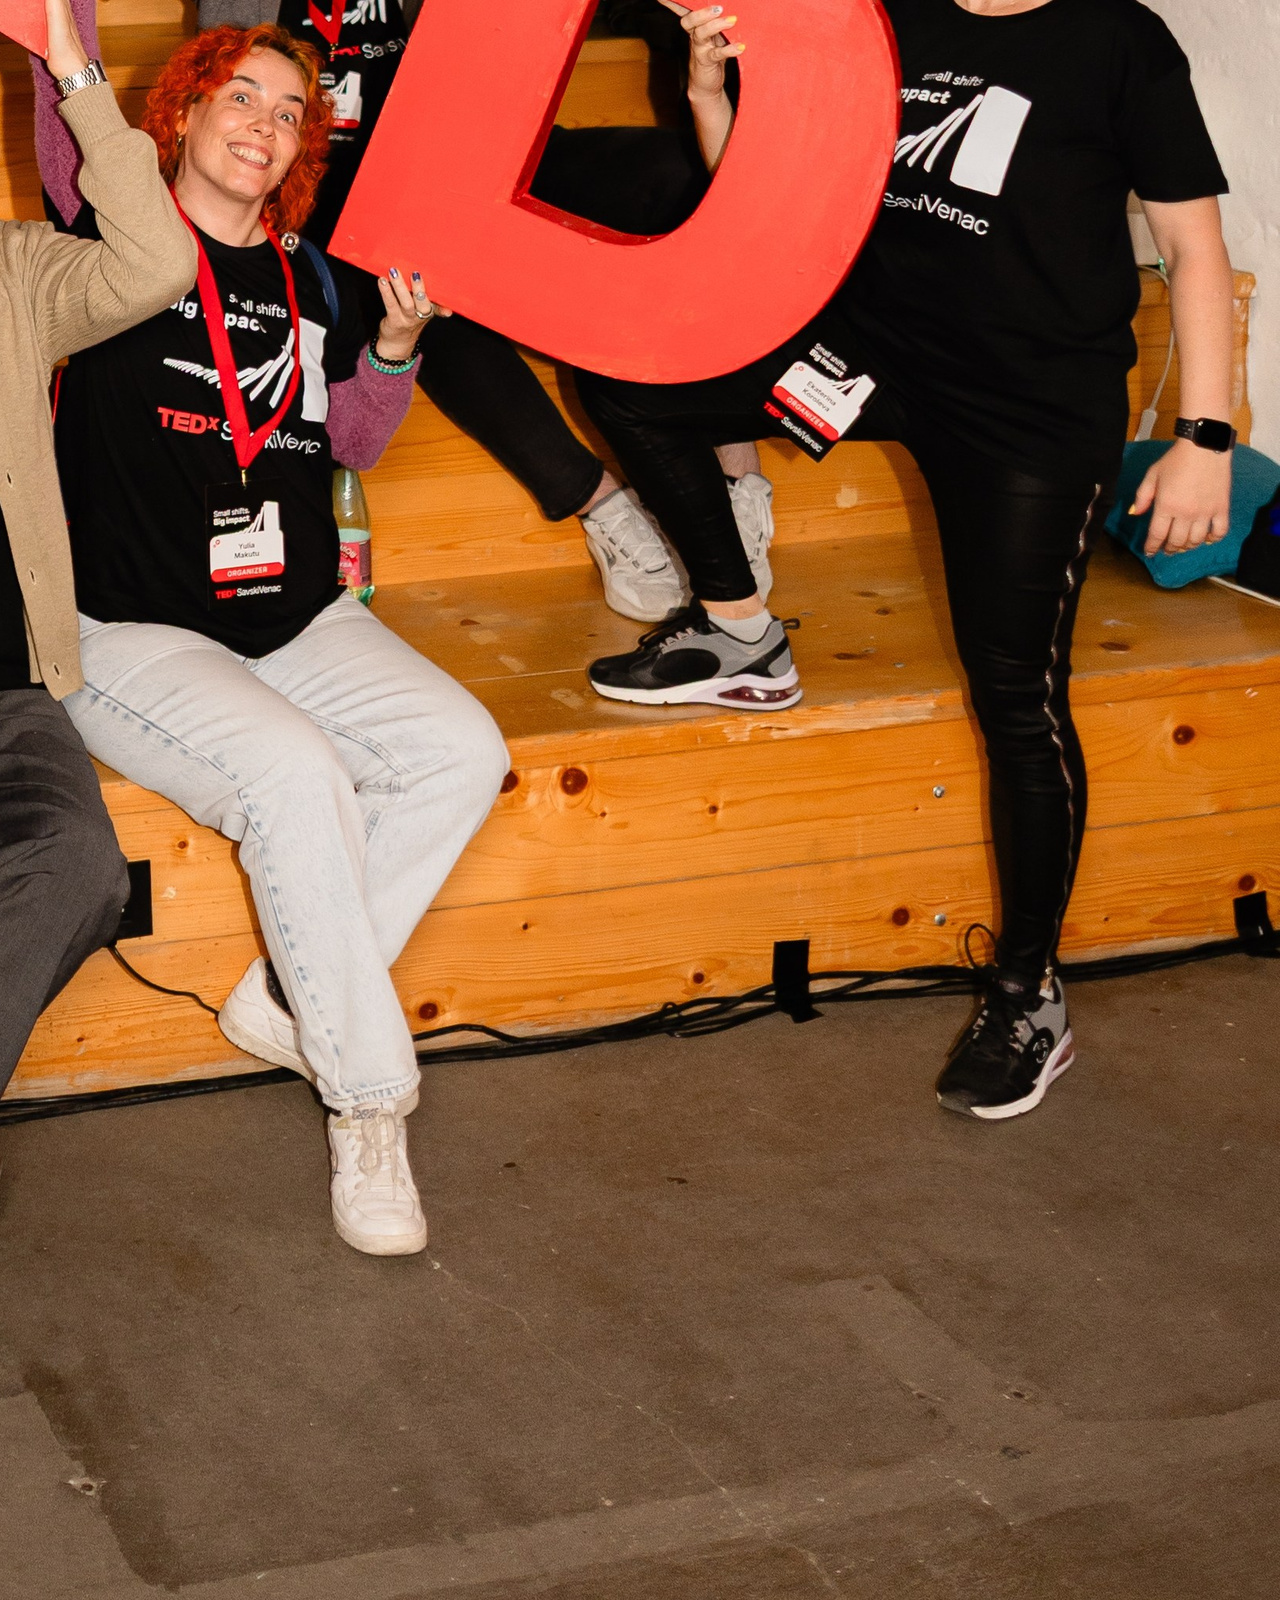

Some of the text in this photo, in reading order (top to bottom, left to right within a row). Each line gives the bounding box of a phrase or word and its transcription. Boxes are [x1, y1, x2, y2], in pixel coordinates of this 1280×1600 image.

[899, 87, 952, 105] mpact
[170, 297, 198, 319] ig
[228, 293, 288, 319] sall shifts
[808, 348, 822, 363] Big
[814, 342, 833, 359] Small
[806, 380, 837, 407] Ekaterina
[157, 406, 221, 435] TEDx
[786, 396, 825, 429] ORGANIZER
[781, 416, 824, 453] SavskiVenac
[213, 509, 231, 519] Small
[213, 517, 226, 527] Big
[233, 550, 260, 560] Makutu
[238, 542, 256, 551] Yulia
[227, 565, 269, 578] ORGANIZER
[236, 584, 282, 598] SavskiVenac
